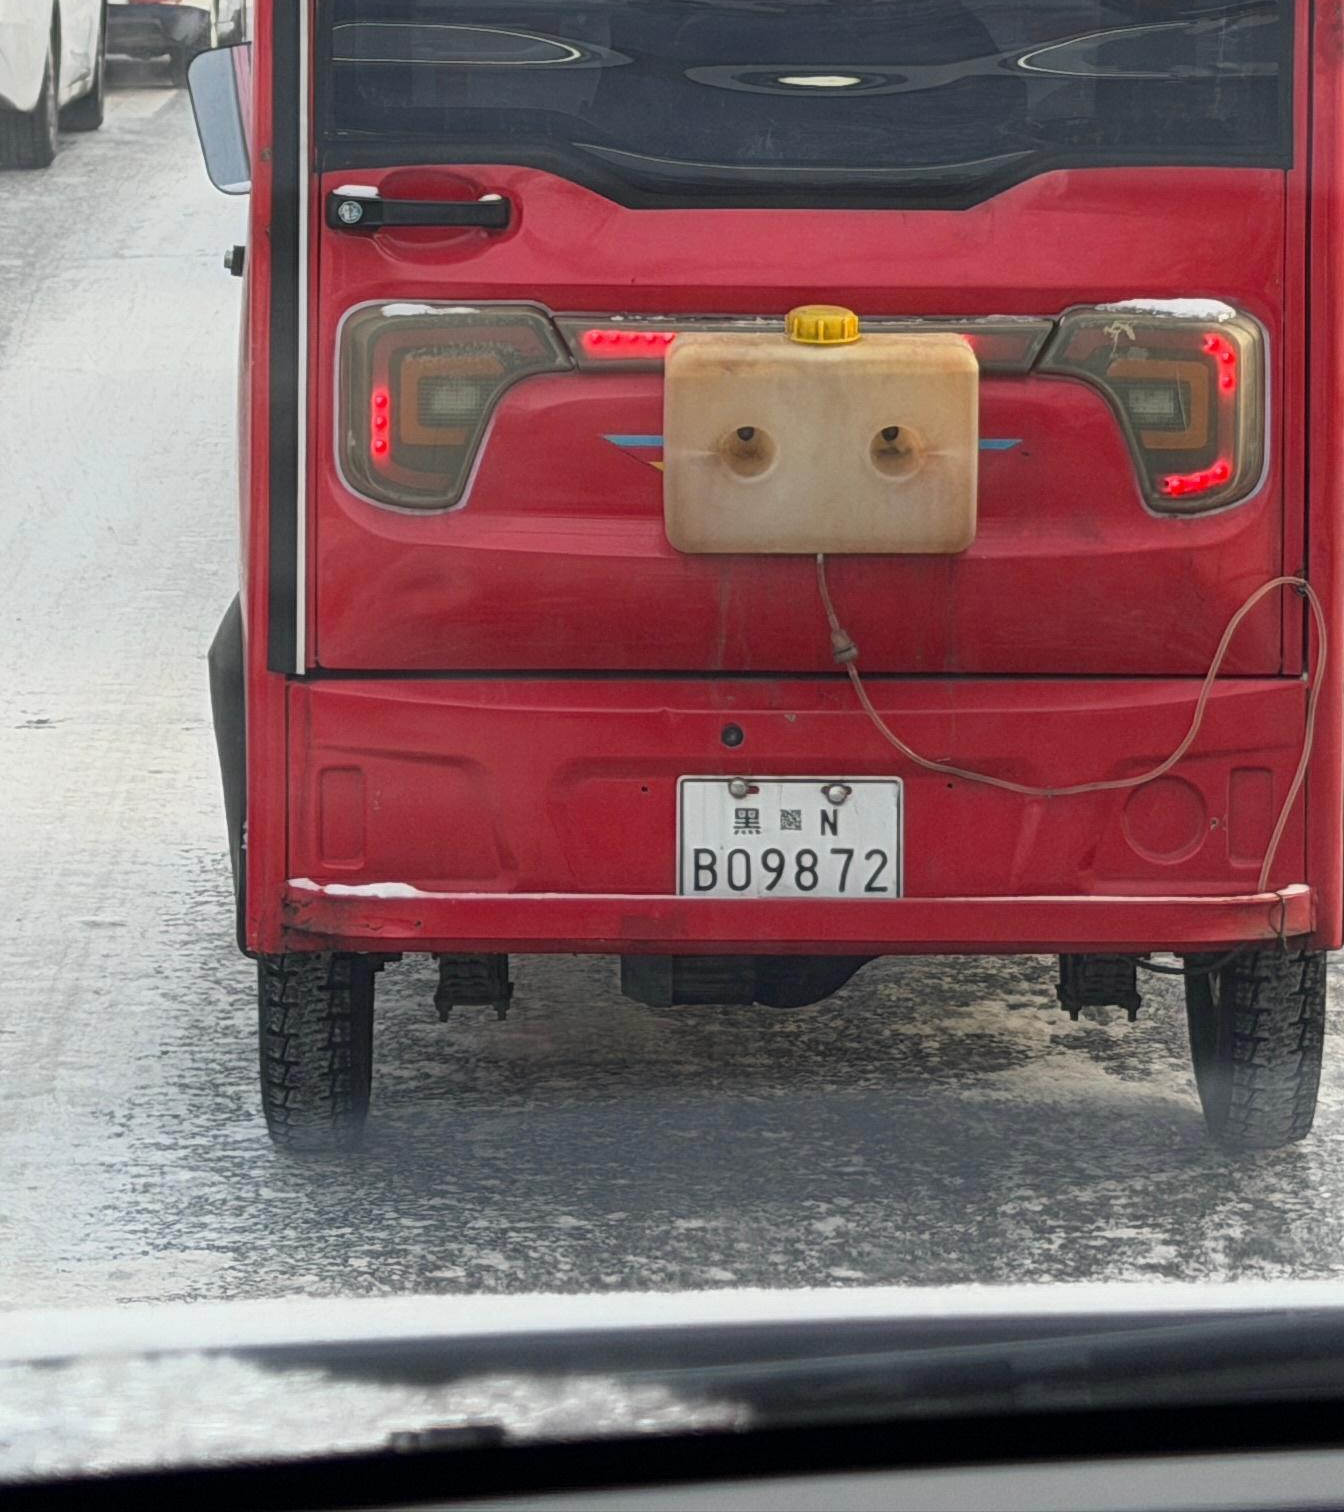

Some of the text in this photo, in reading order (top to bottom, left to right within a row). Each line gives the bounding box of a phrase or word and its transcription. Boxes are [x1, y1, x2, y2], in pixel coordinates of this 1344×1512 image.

[733, 807, 838, 836] 黑 N
[693, 847, 889, 893] B09872
